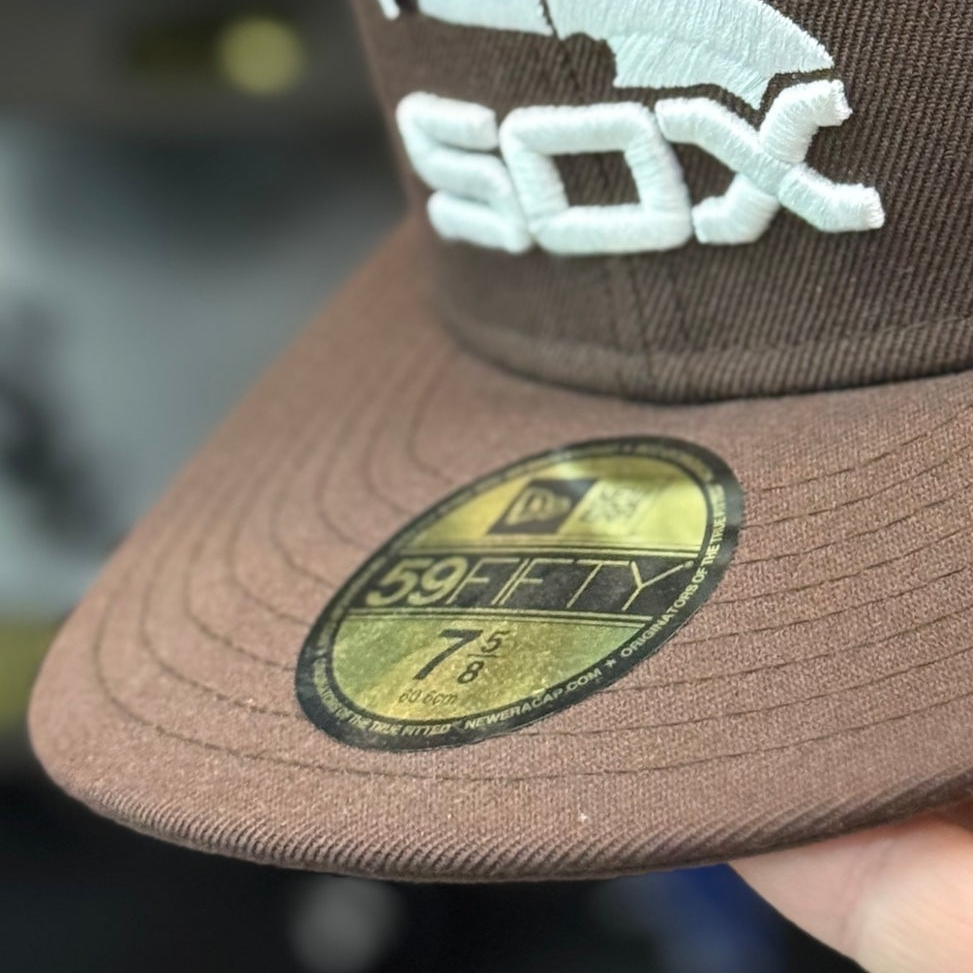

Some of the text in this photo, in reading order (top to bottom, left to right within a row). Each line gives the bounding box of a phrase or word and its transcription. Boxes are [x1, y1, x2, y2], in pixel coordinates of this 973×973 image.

[396, 79, 886, 255] SOX
[366, 556, 692, 611] 59FIFTY
[620, 583, 699, 658] ORIGINATORS
[692, 567, 708, 584] OF
[701, 543, 720, 567] THE
[412, 628, 484, 681] 7
[399, 689, 458, 706] 606cm
[463, 666, 603, 730] NEWERACAP.COM
[401, 724, 452, 737] FITTED
